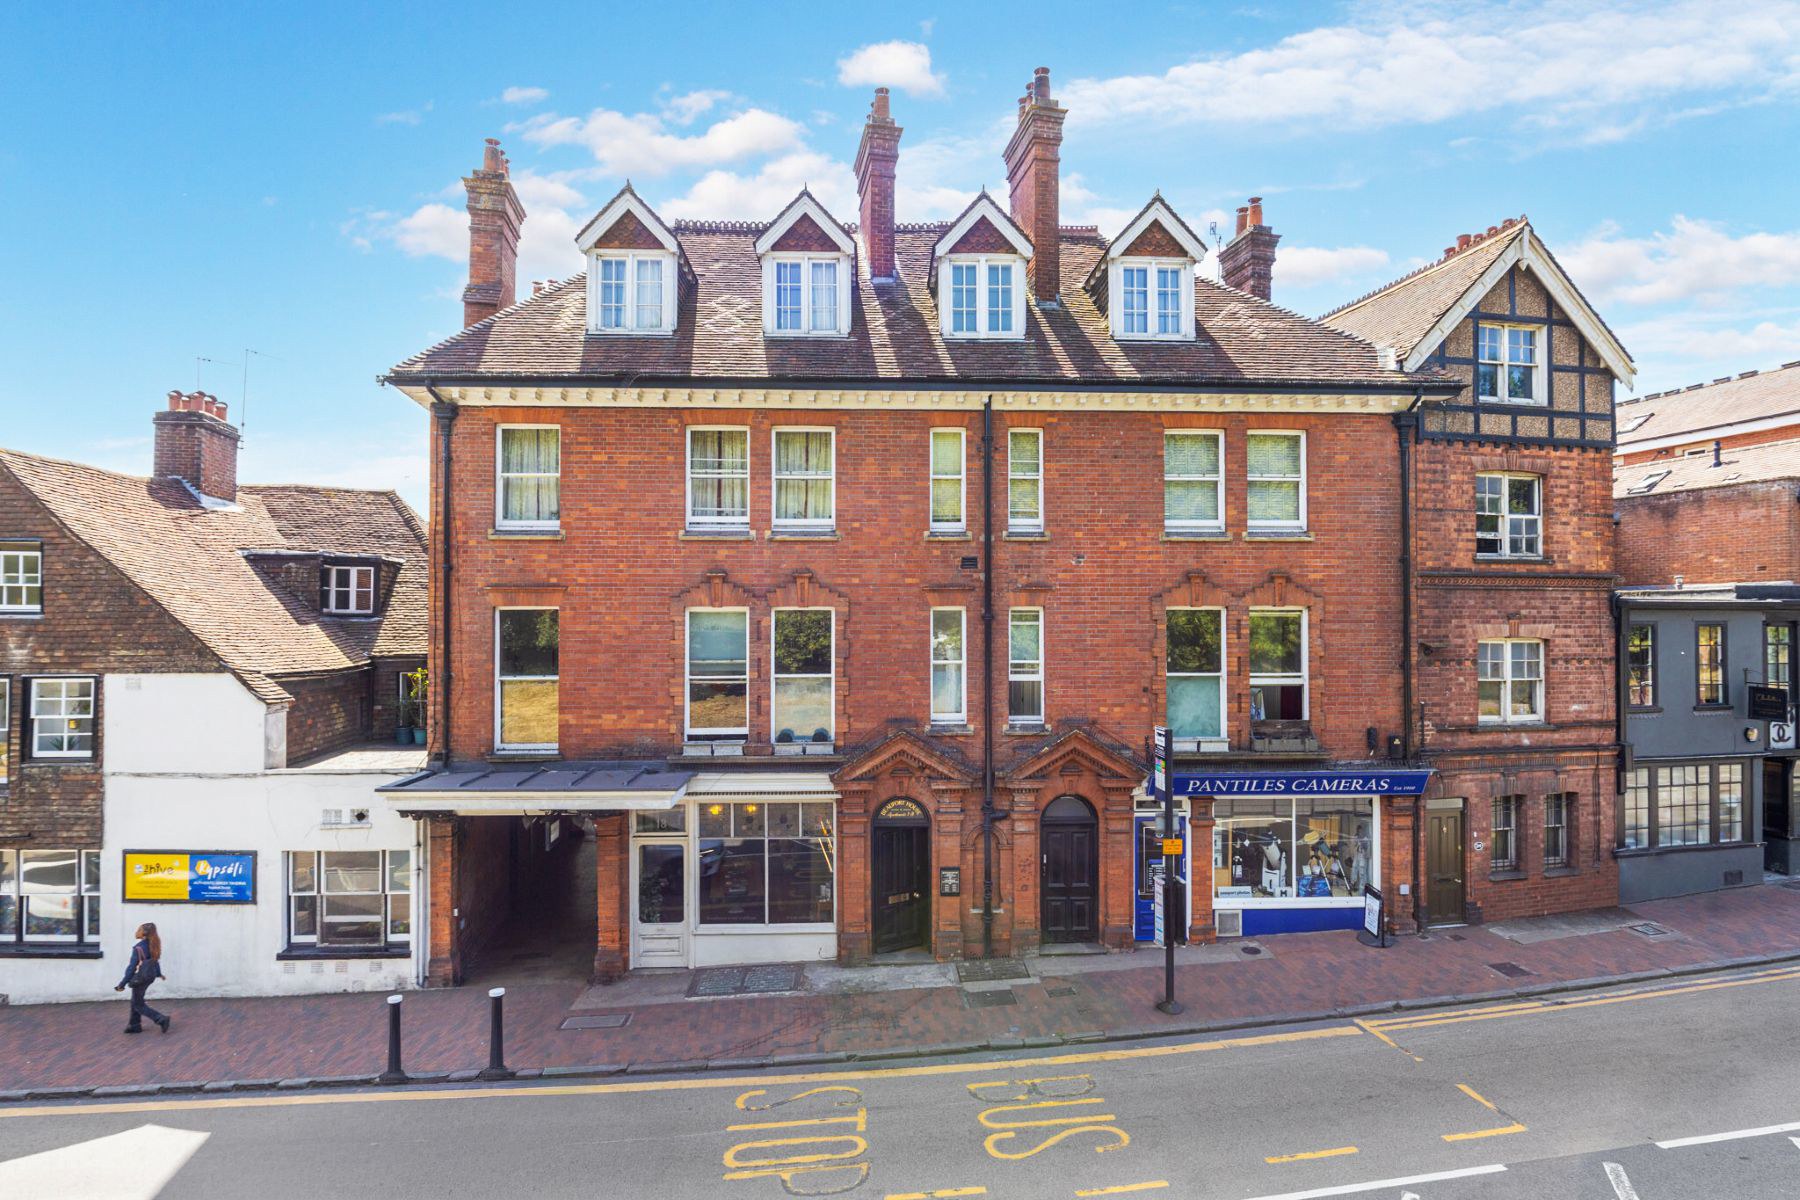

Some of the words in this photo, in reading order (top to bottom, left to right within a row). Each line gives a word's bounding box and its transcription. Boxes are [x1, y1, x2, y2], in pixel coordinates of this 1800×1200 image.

[1187, 778, 1285, 792] PANTILES
[1291, 778, 1389, 791] CAMERAS
[880, 799, 906, 816] BEAUFORT
[906, 800, 922, 815] HOUSE
[656, 818, 667, 829] 18
[966, 1074, 1130, 1160] BUS
[722, 1086, 872, 1196] STOP
